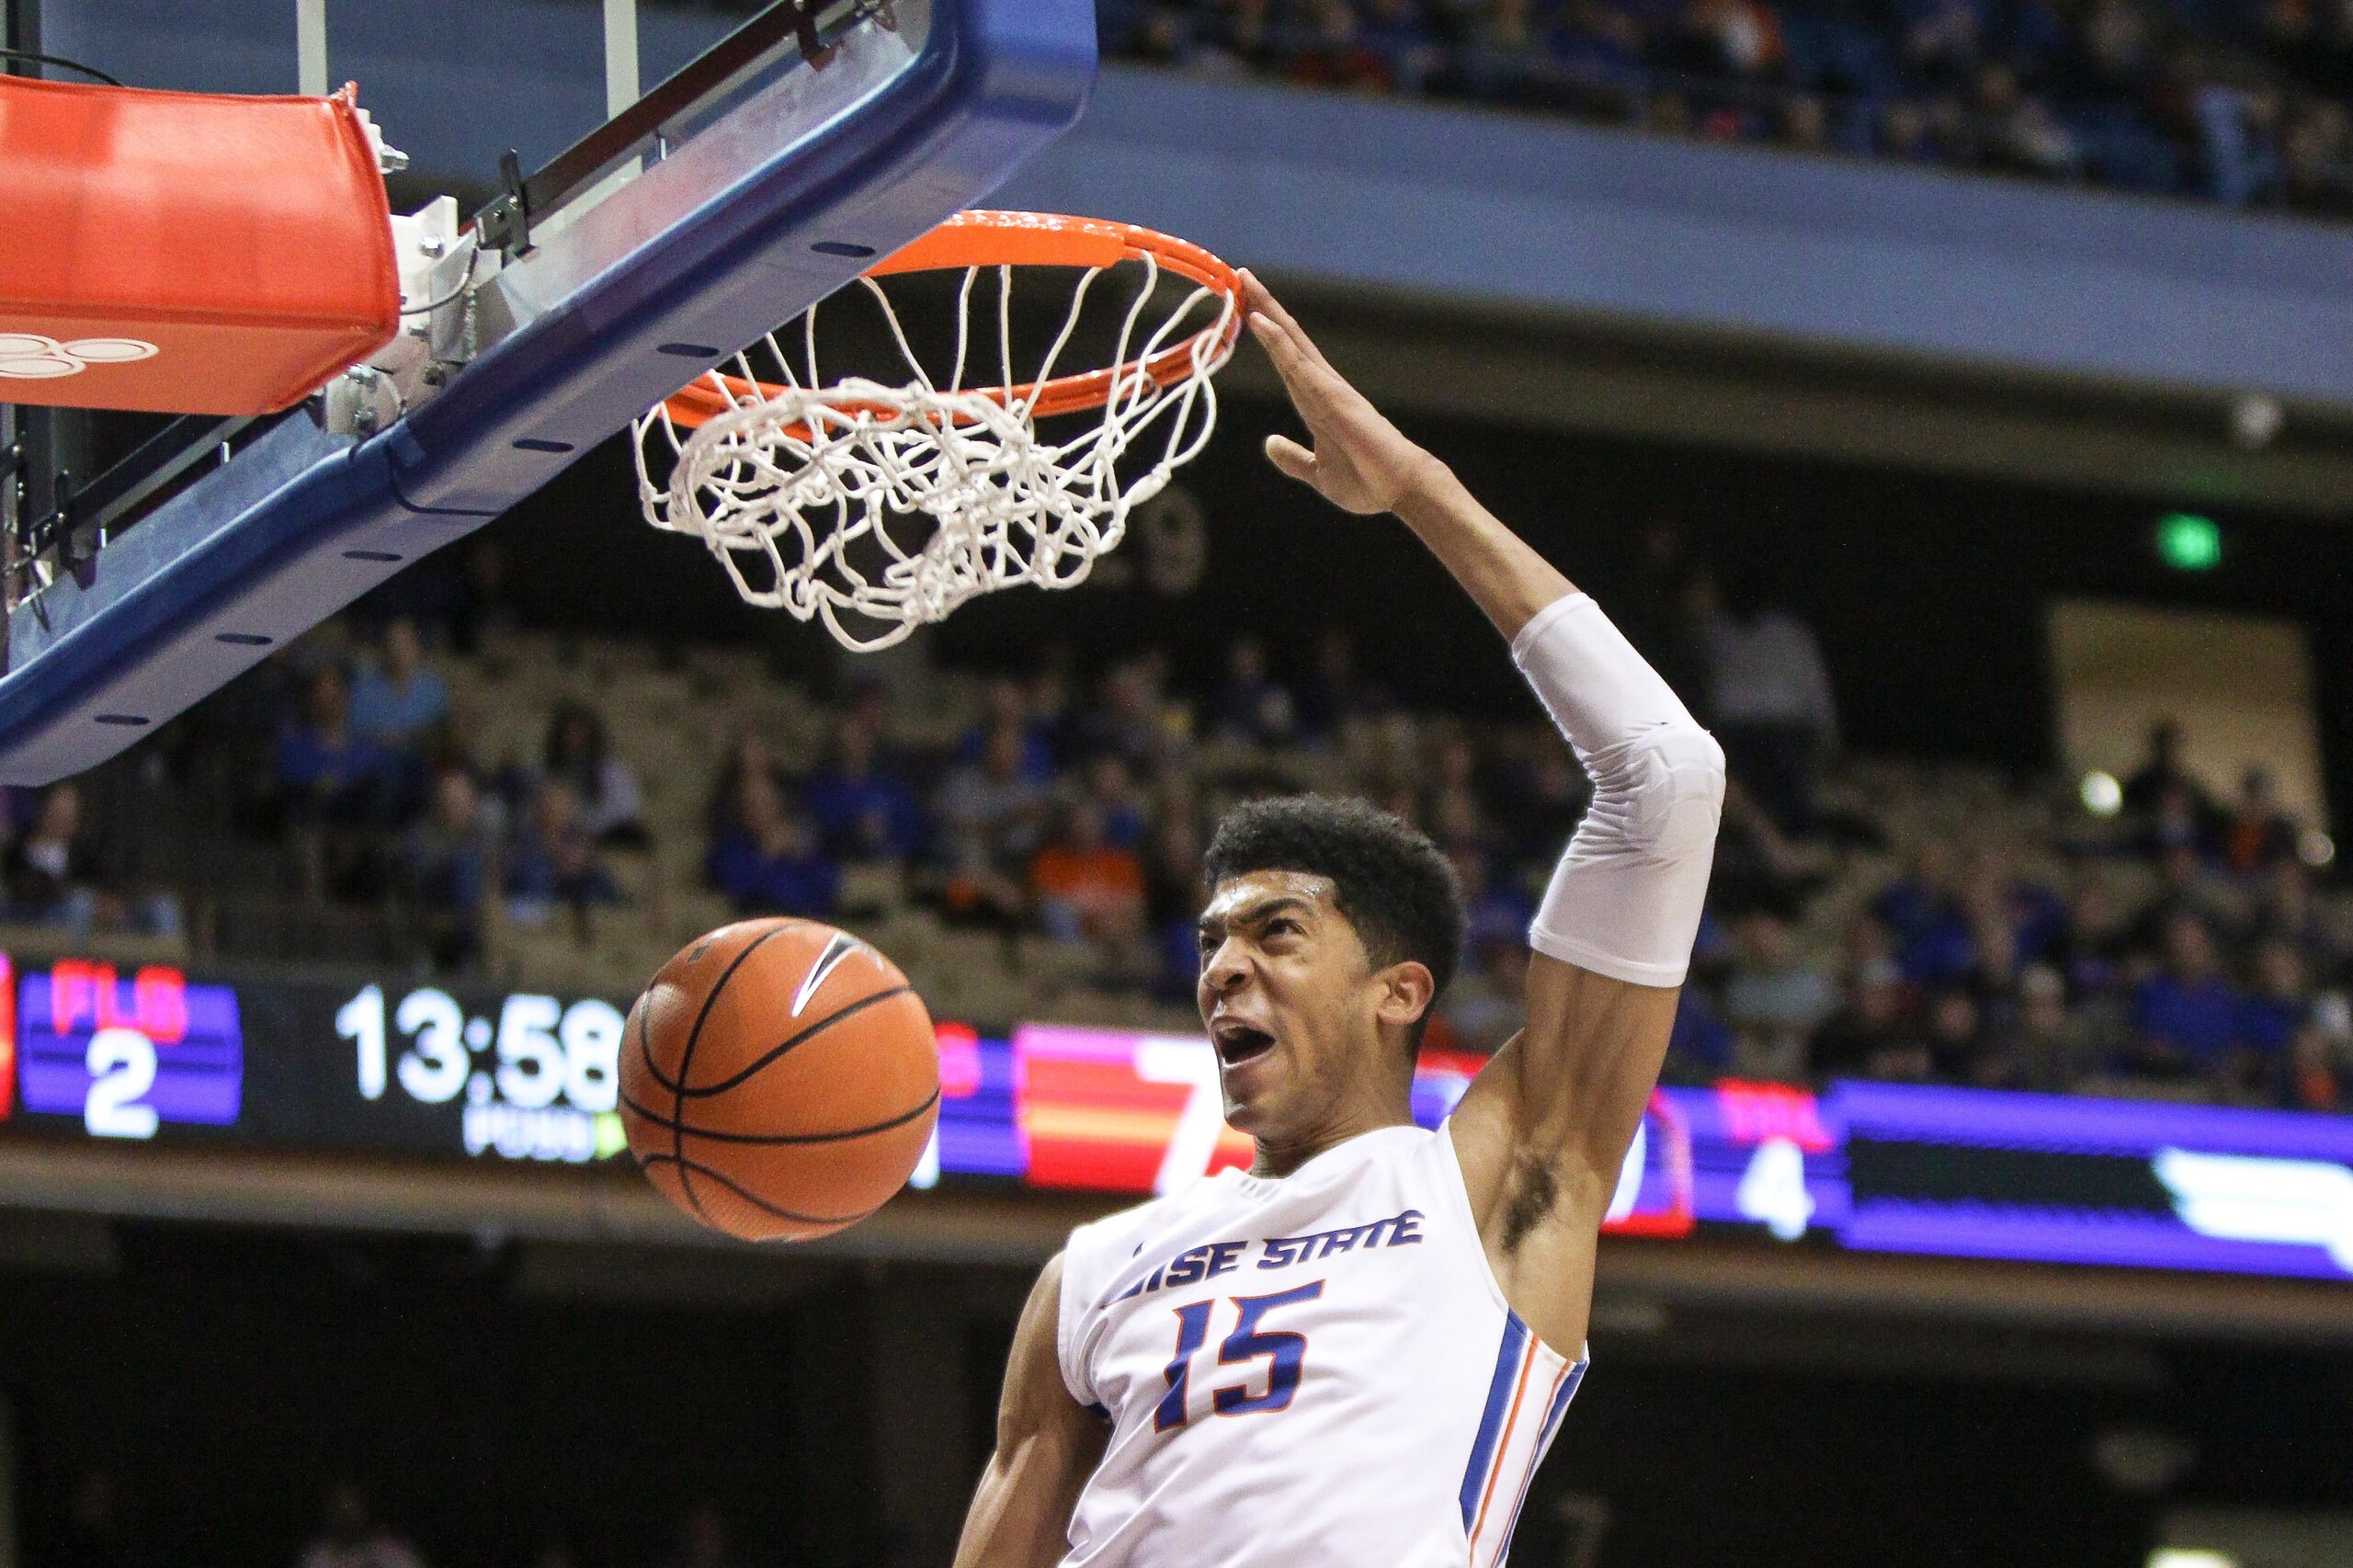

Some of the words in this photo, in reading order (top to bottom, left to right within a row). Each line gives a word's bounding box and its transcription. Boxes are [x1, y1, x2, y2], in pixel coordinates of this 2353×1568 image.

[85, 1027, 160, 1139] 2
[335, 983, 625, 1113] 13:58
[1736, 1136, 1815, 1242] 4
[1099, 1240, 1249, 1310] ISE
[1256, 1210, 1427, 1271] STATE
[1154, 1278, 1326, 1434] 15
